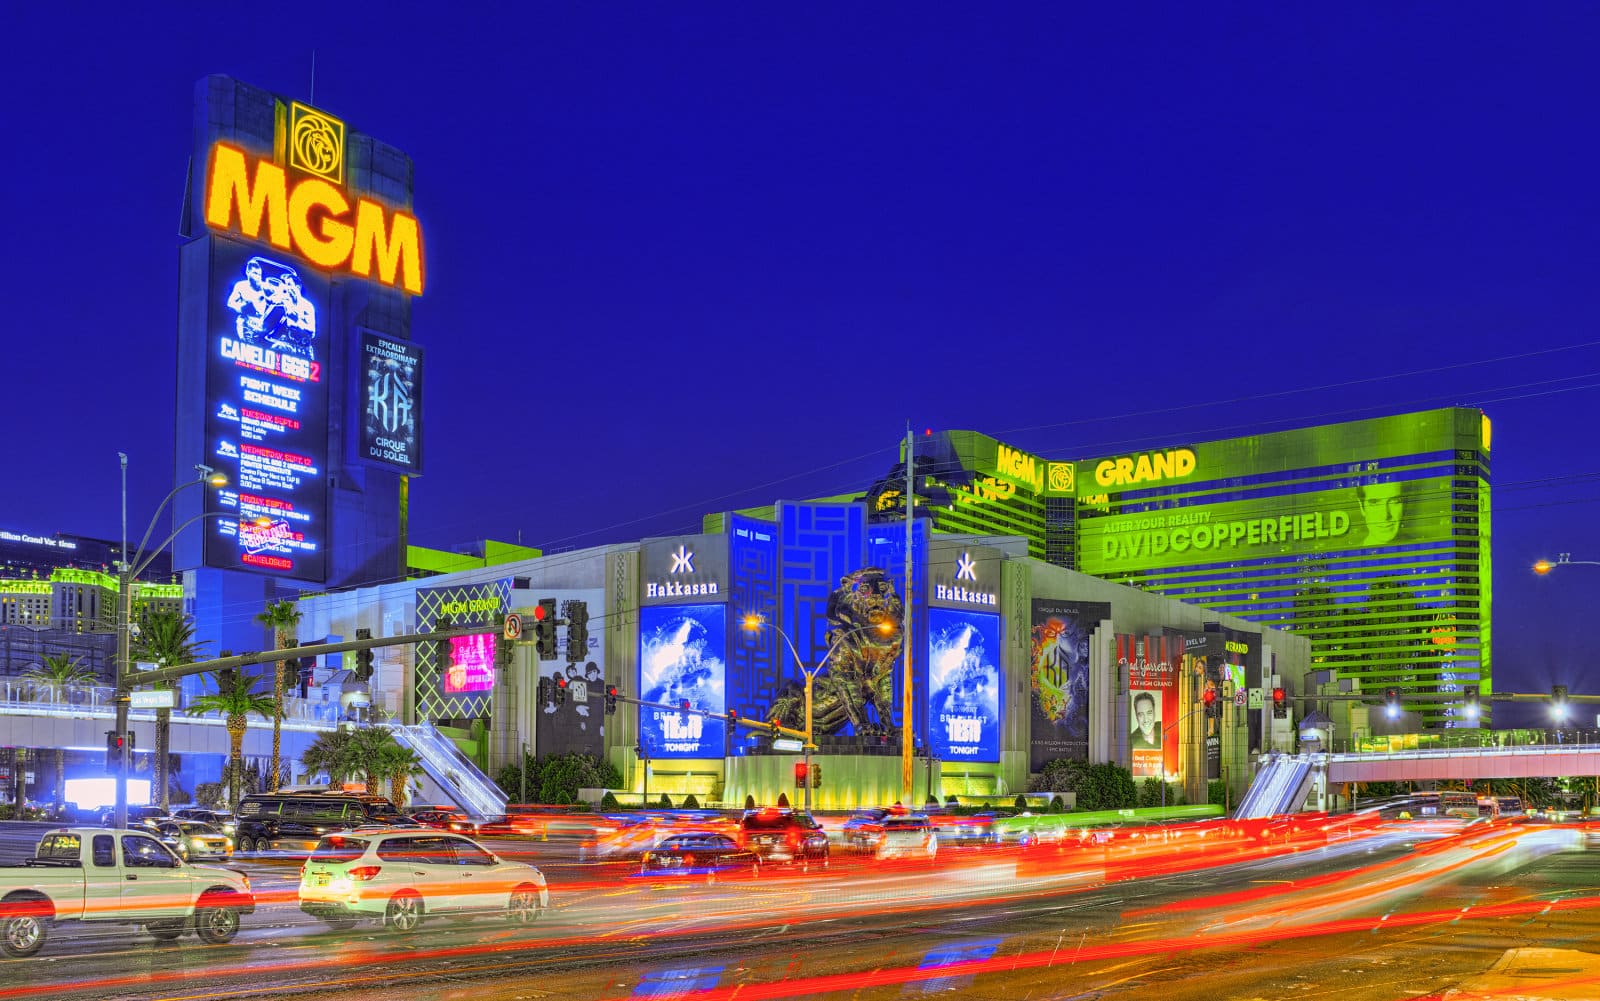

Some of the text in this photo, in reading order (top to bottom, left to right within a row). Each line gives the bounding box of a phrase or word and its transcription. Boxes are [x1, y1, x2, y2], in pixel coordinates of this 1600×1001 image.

[206, 143, 424, 297] MGM
[366, 344, 418, 366] EXTRAORDINARY
[378, 340, 406, 354] EPICALLY
[221, 337, 276, 370] CANELO
[309, 361, 320, 382] 2
[240, 376, 301, 401] FIGHT WEEK
[243, 390, 297, 412] SCHEDULE
[370, 447, 411, 464] DU SOLEIL
[375, 437, 406, 453] CIRQUE
[997, 444, 1035, 486] MGM
[1095, 449, 1197, 487] GRAND
[1103, 511, 1212, 534] ALTER YOUR REALITY
[21, 534, 44, 545] Grand
[647, 581, 718, 597] Hakkasan
[937, 584, 996, 605] Hakkasan
[441, 597, 499, 614] MGM GRAND
[664, 742, 700, 752] TONIGHT
[949, 745, 979, 755] TONIGHT
